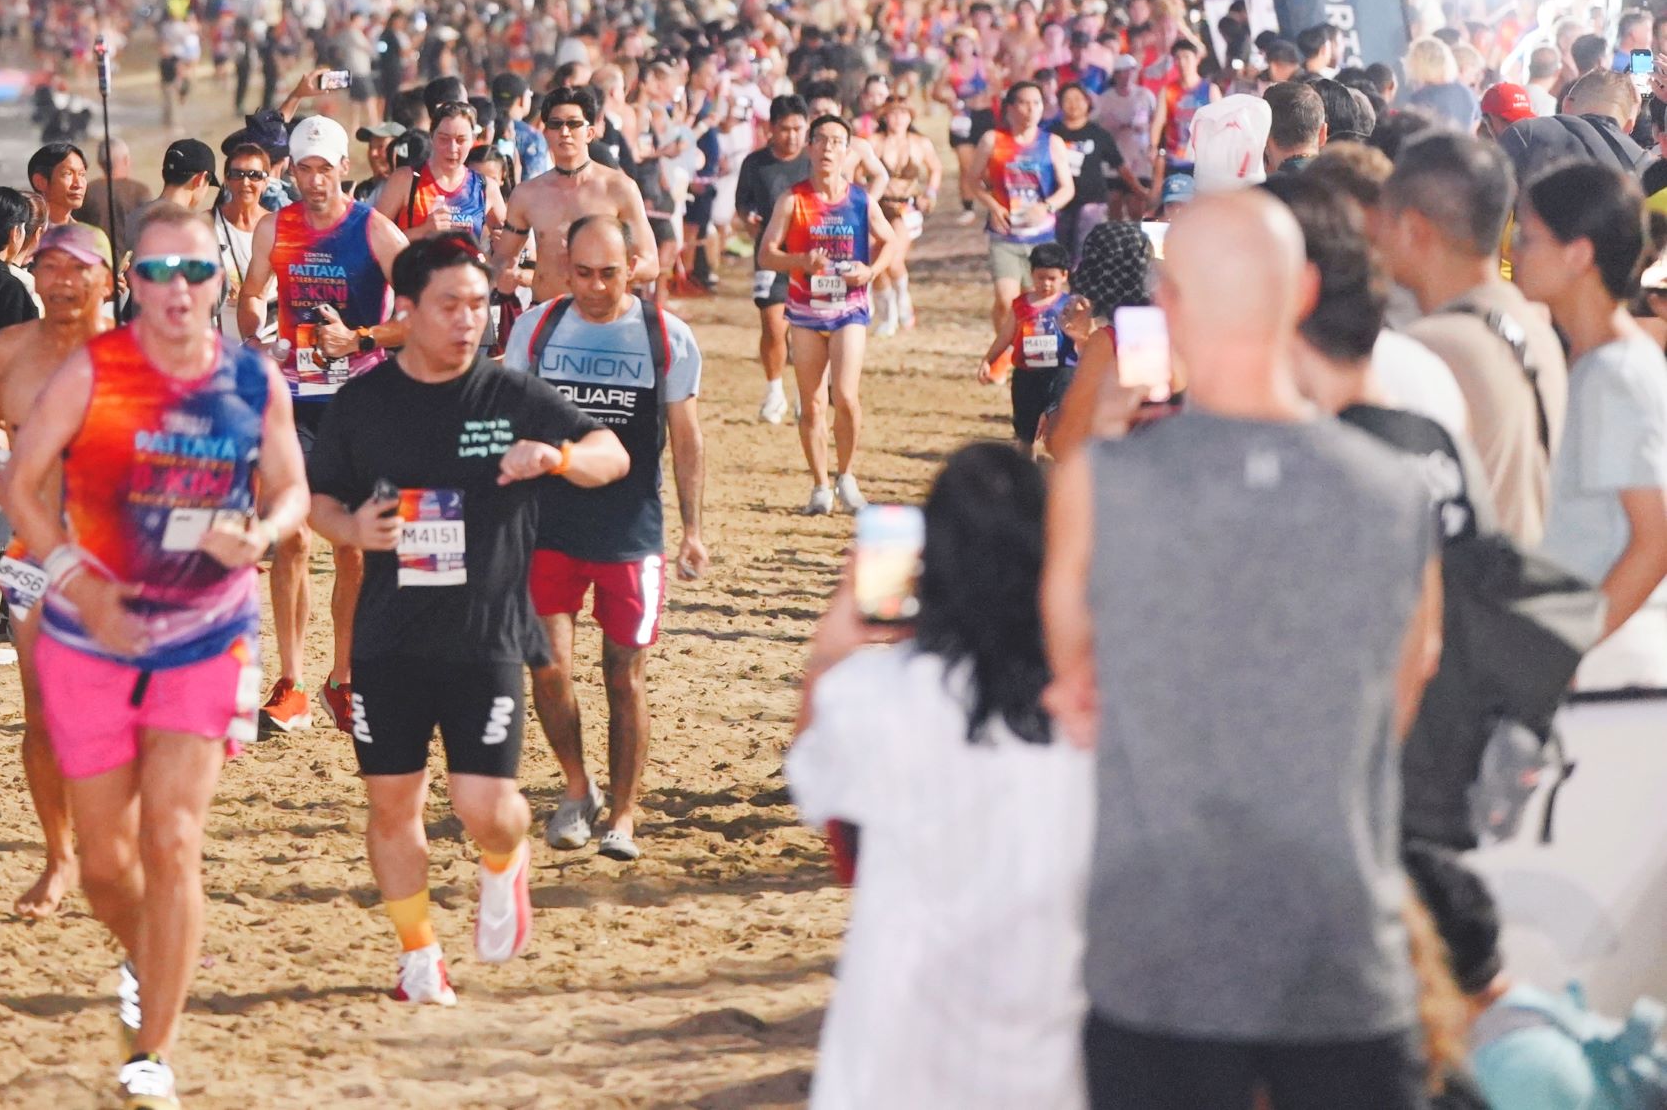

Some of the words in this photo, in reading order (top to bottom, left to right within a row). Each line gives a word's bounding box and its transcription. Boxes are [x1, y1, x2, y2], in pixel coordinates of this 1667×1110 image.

[289, 264, 346, 277] PATTAYA
[541, 352, 642, 379] UNION
[556, 385, 637, 408] QUARE
[134, 430, 237, 460] PATTAYA
[402, 528, 458, 543] M4151
